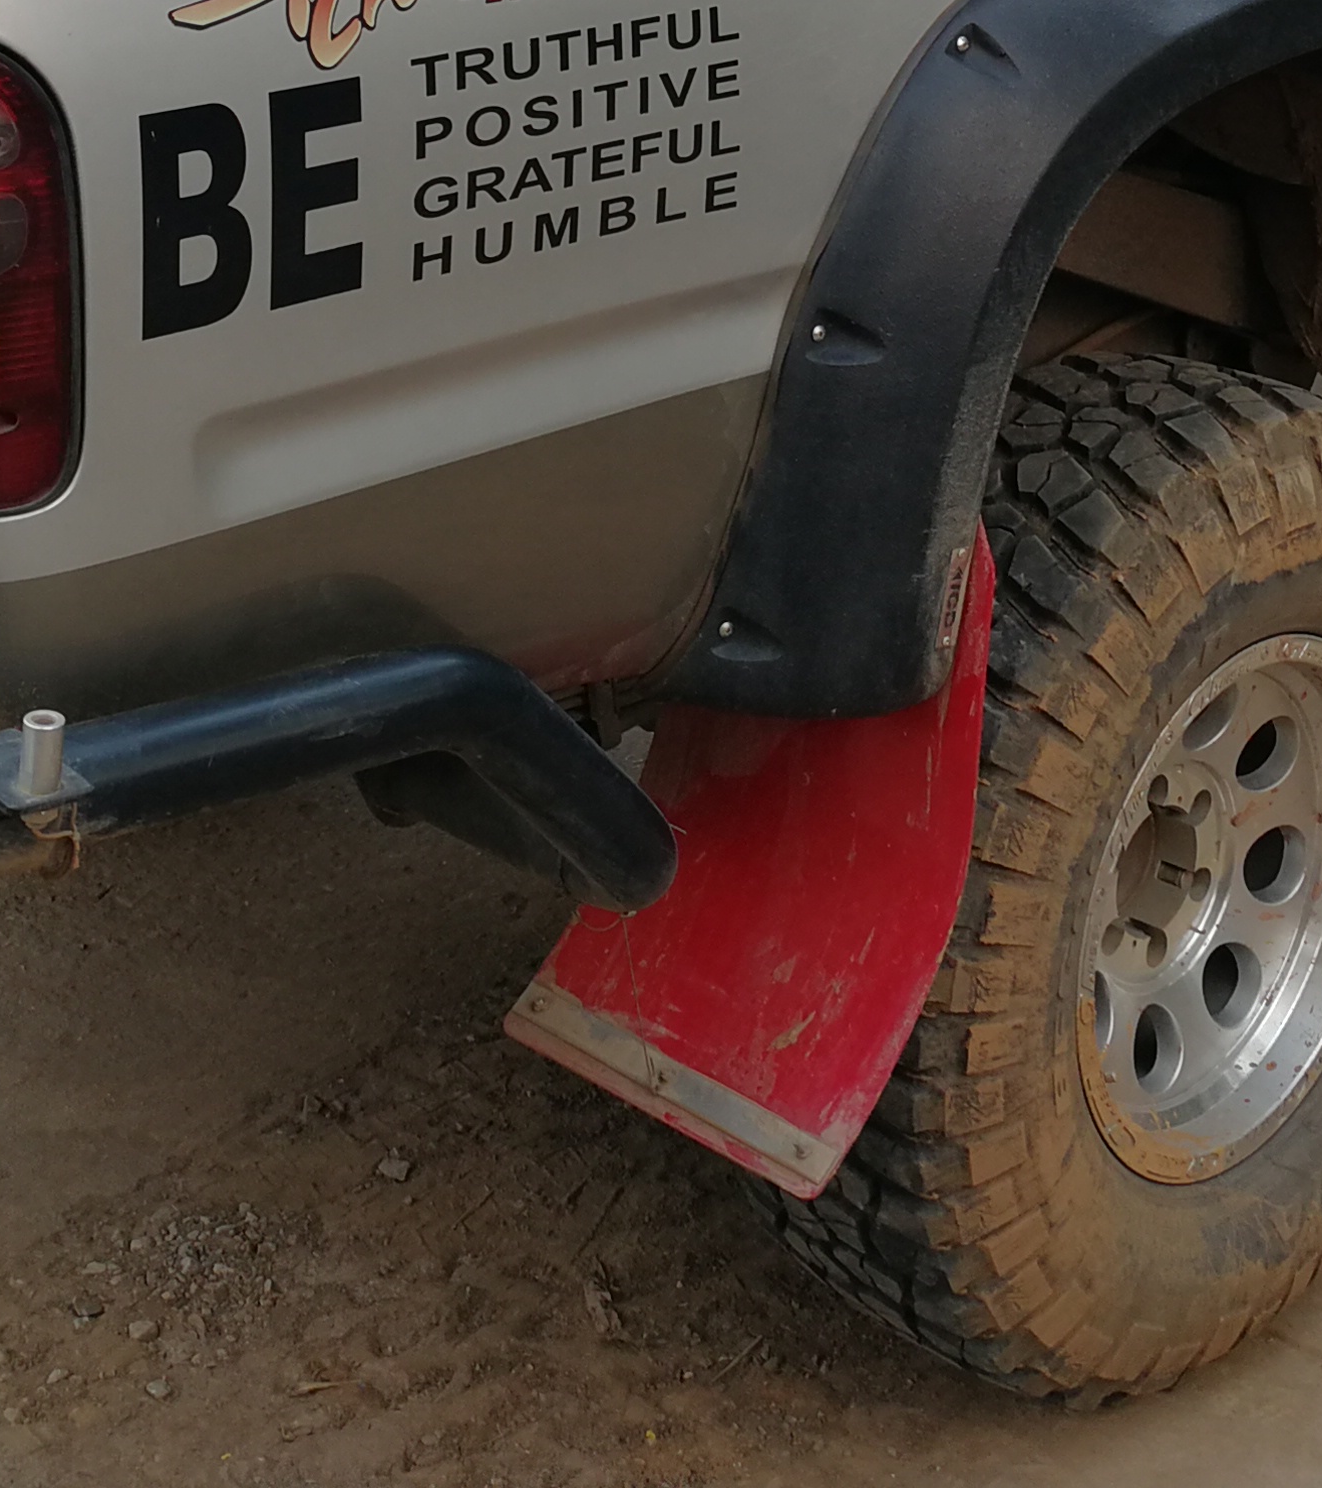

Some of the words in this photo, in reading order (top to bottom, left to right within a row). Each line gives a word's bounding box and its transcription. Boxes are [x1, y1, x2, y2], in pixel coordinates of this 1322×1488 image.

[411, 6, 741, 97] TRUTHFUL
[415, 59, 741, 160] POSITIVE
[138, 75, 364, 341] BE
[413, 119, 741, 219] GRATEFUL
[412, 171, 739, 282] HUMBLE
